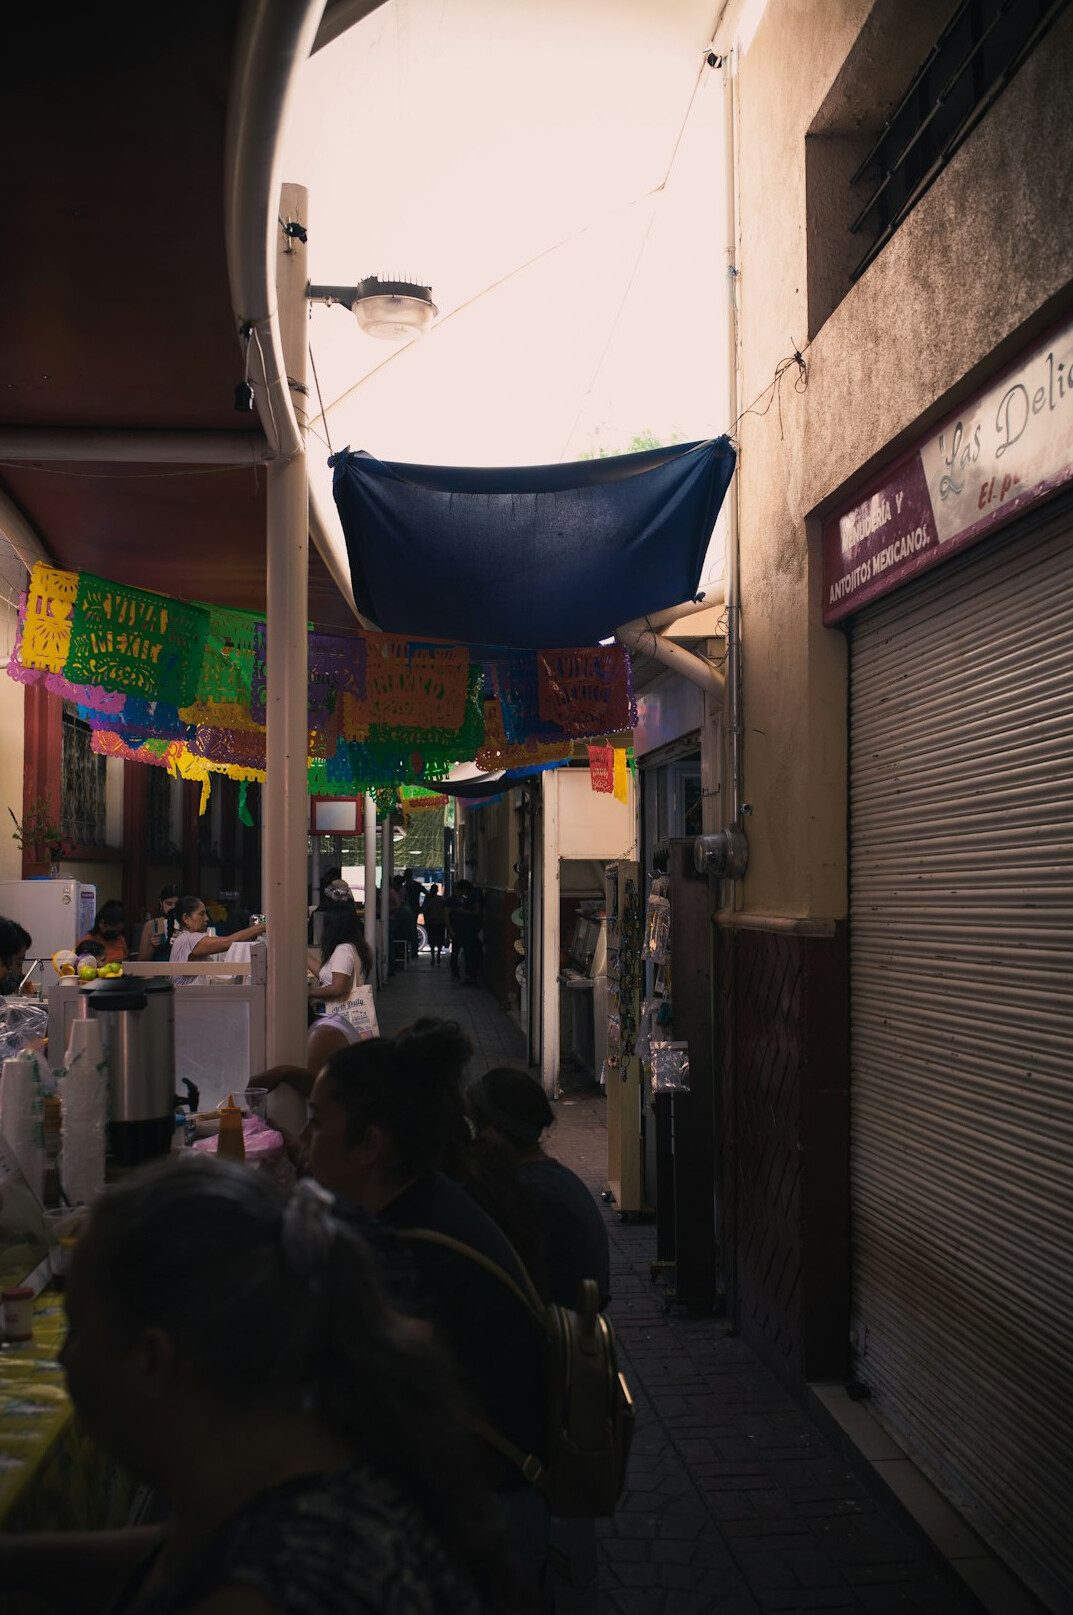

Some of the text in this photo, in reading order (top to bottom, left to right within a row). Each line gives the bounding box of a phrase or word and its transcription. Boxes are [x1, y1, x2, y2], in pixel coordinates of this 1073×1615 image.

[895, 490, 904, 514] Y
[978, 476, 995, 510] El
[829, 559, 872, 605] ANTOJITOS
